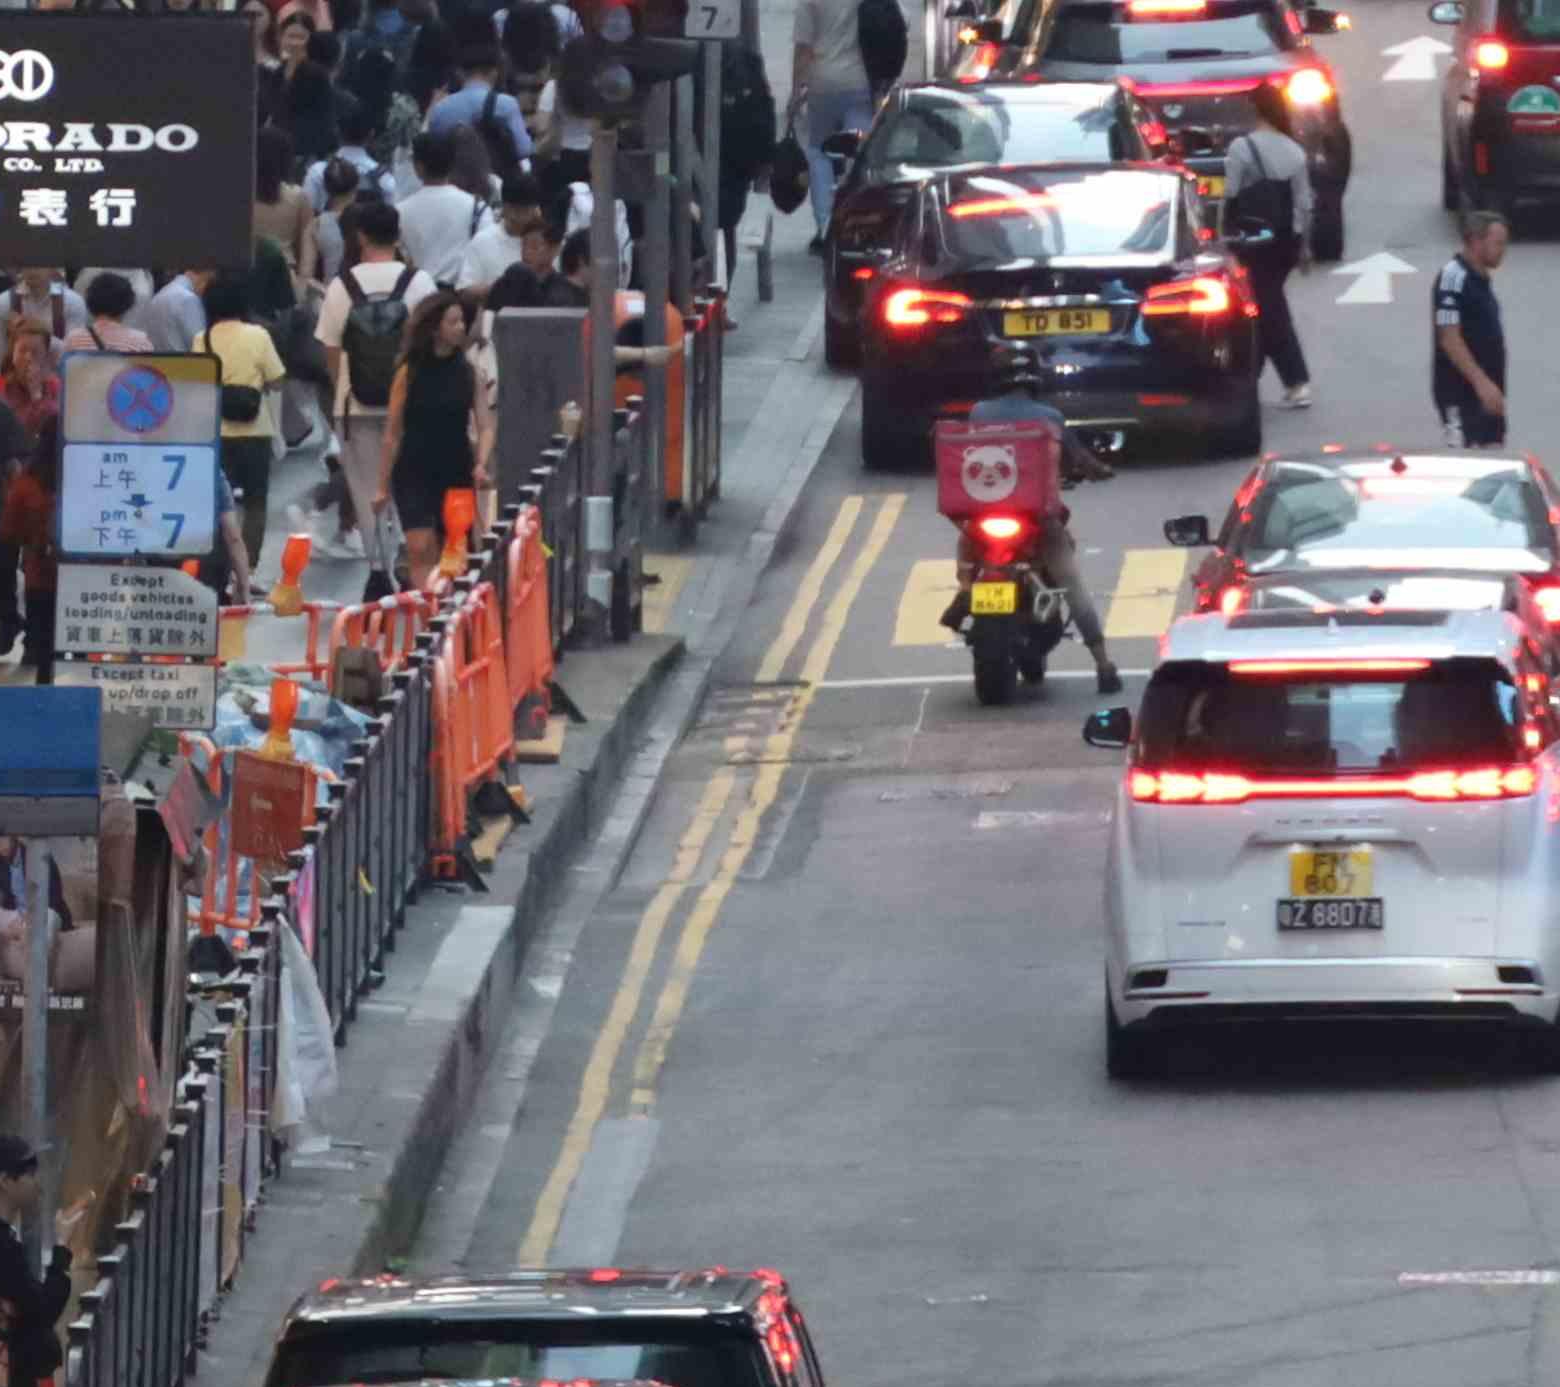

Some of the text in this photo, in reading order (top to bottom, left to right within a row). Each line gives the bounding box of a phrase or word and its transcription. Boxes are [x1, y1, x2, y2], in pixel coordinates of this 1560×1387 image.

[701, 6, 719, 30] 7
[93, 469, 137, 490] 上午
[102, 451, 187, 491] am 7
[93, 527, 137, 547] 下午
[100, 509, 186, 549] pm 7
[110, 574, 165, 589] Except
[80, 590, 195, 605] goods vehicles
[65, 607, 208, 625] loading/unloading
[91, 666, 180, 683] Except taxi
[108, 687, 199, 705] up/drop off
